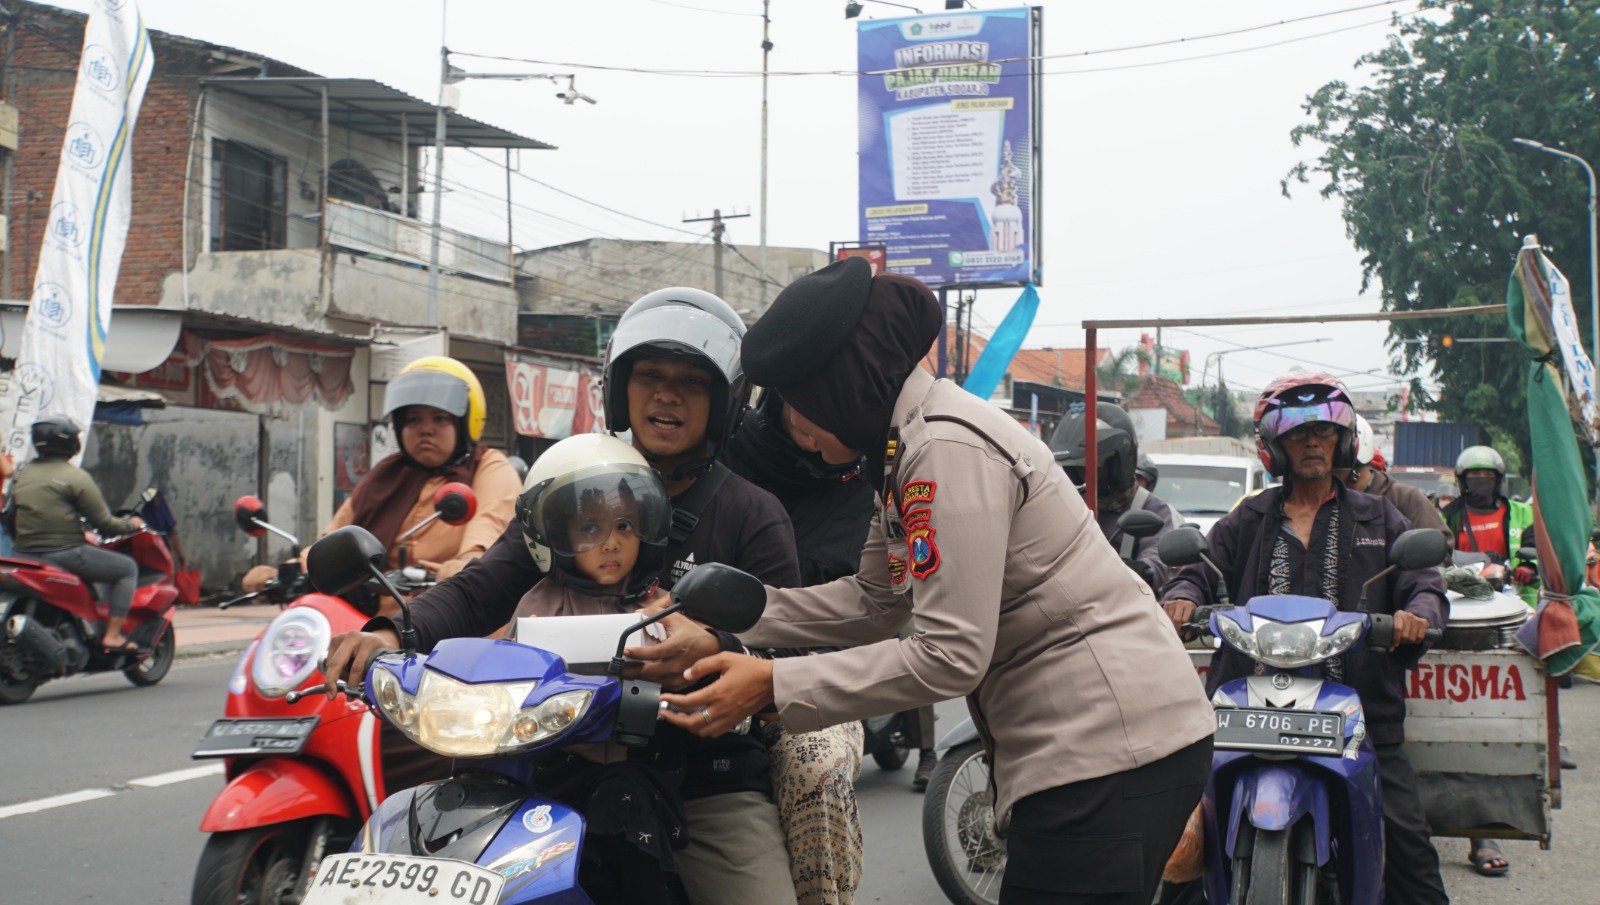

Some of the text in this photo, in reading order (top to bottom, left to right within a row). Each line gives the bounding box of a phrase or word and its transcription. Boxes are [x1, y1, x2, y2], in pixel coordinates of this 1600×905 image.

[896, 42, 988, 68] INFORMASI
[886, 64, 998, 89] PAJAK DAERAH
[1218, 713, 1333, 734] W 6706 PE
[320, 857, 361, 887] AE
[362, 860, 439, 893] 2599
[450, 870, 492, 905] GD
